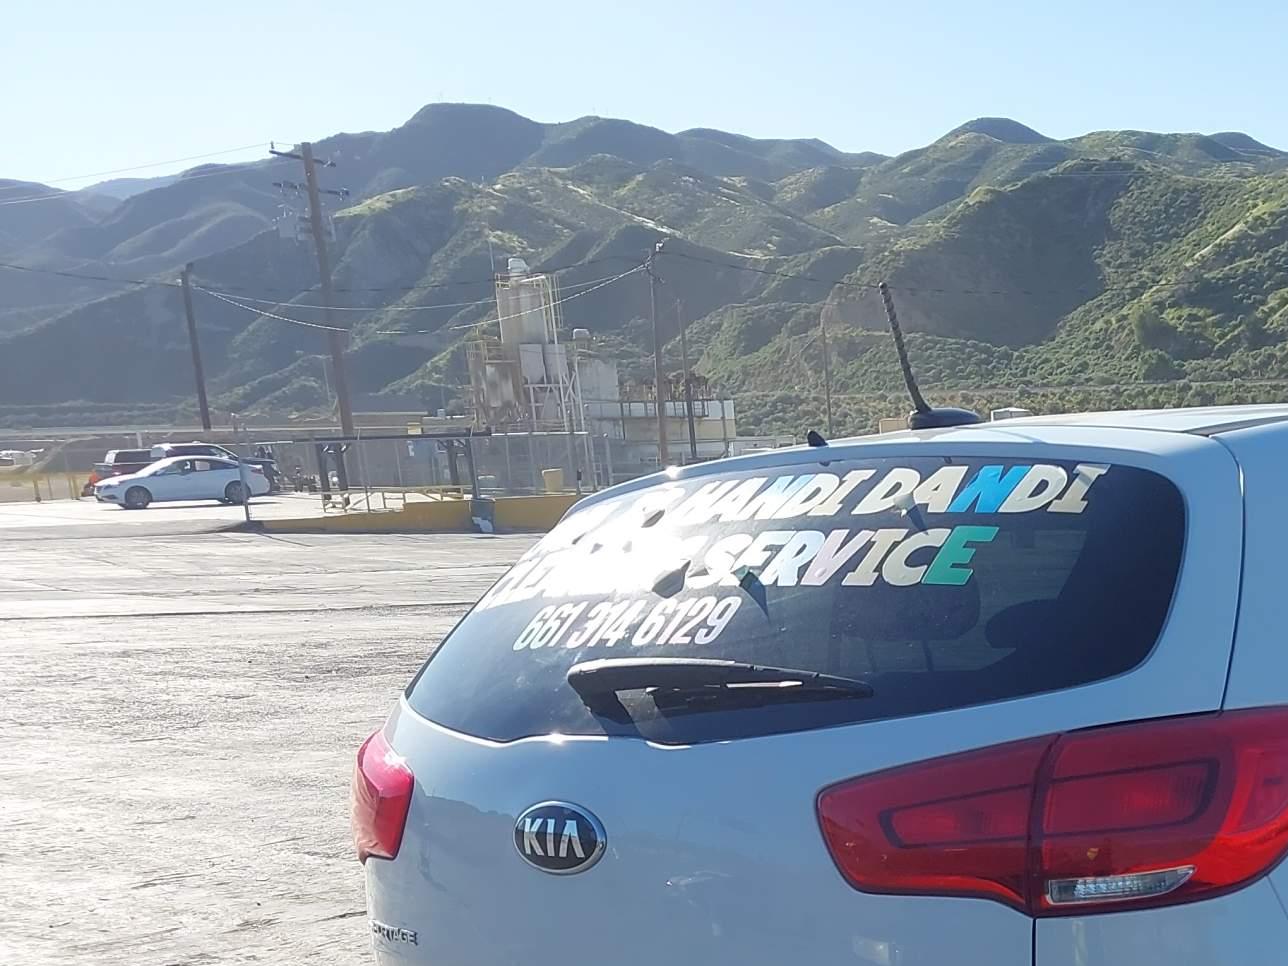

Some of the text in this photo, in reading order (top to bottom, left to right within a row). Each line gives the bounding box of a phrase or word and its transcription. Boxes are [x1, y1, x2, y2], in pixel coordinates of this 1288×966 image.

[677, 469, 878, 525] HANDI
[853, 463, 1111, 515] DANDI
[684, 525, 1000, 589] SERVICE
[513, 596, 742, 651] 661 314 6129
[523, 817, 585, 859] KIA
